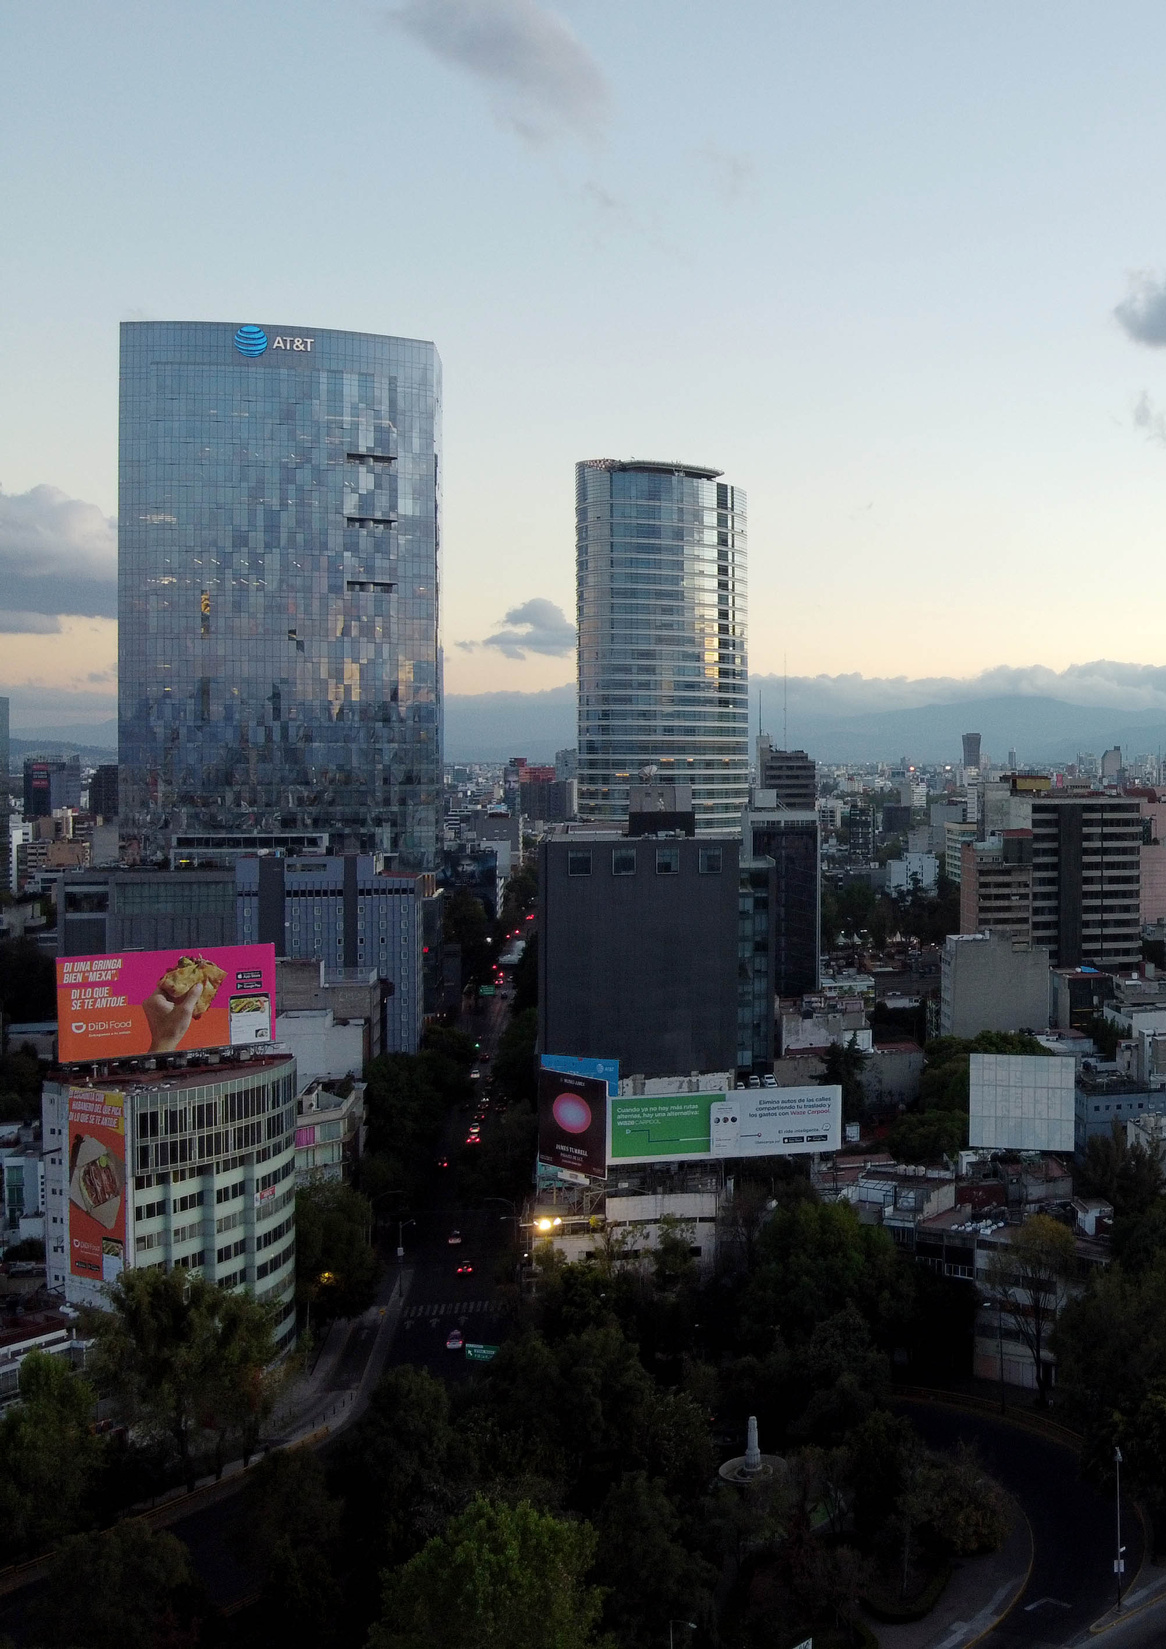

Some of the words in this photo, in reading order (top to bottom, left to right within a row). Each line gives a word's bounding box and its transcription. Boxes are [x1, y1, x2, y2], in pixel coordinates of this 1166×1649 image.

[272, 336, 315, 352] AT&T
[63, 962, 73, 973] DI
[73, 961, 91, 972] UNA
[92, 959, 122, 971] GRINGA
[63, 972, 83, 984] BIEN
[71, 989, 80, 1000] DI
[81, 988, 92, 999] LO
[93, 986, 110, 998] QUE
[71, 1000, 82, 1011] SE
[84, 999, 93, 1009] TE
[95, 996, 127, 1009] ANTOJE.
[88, 1021, 109, 1031] DiDi
[109, 1019, 132, 1029] Food
[755, 1104, 796, 1112] compartiendo
[80, 1113, 89, 1123] QUE
